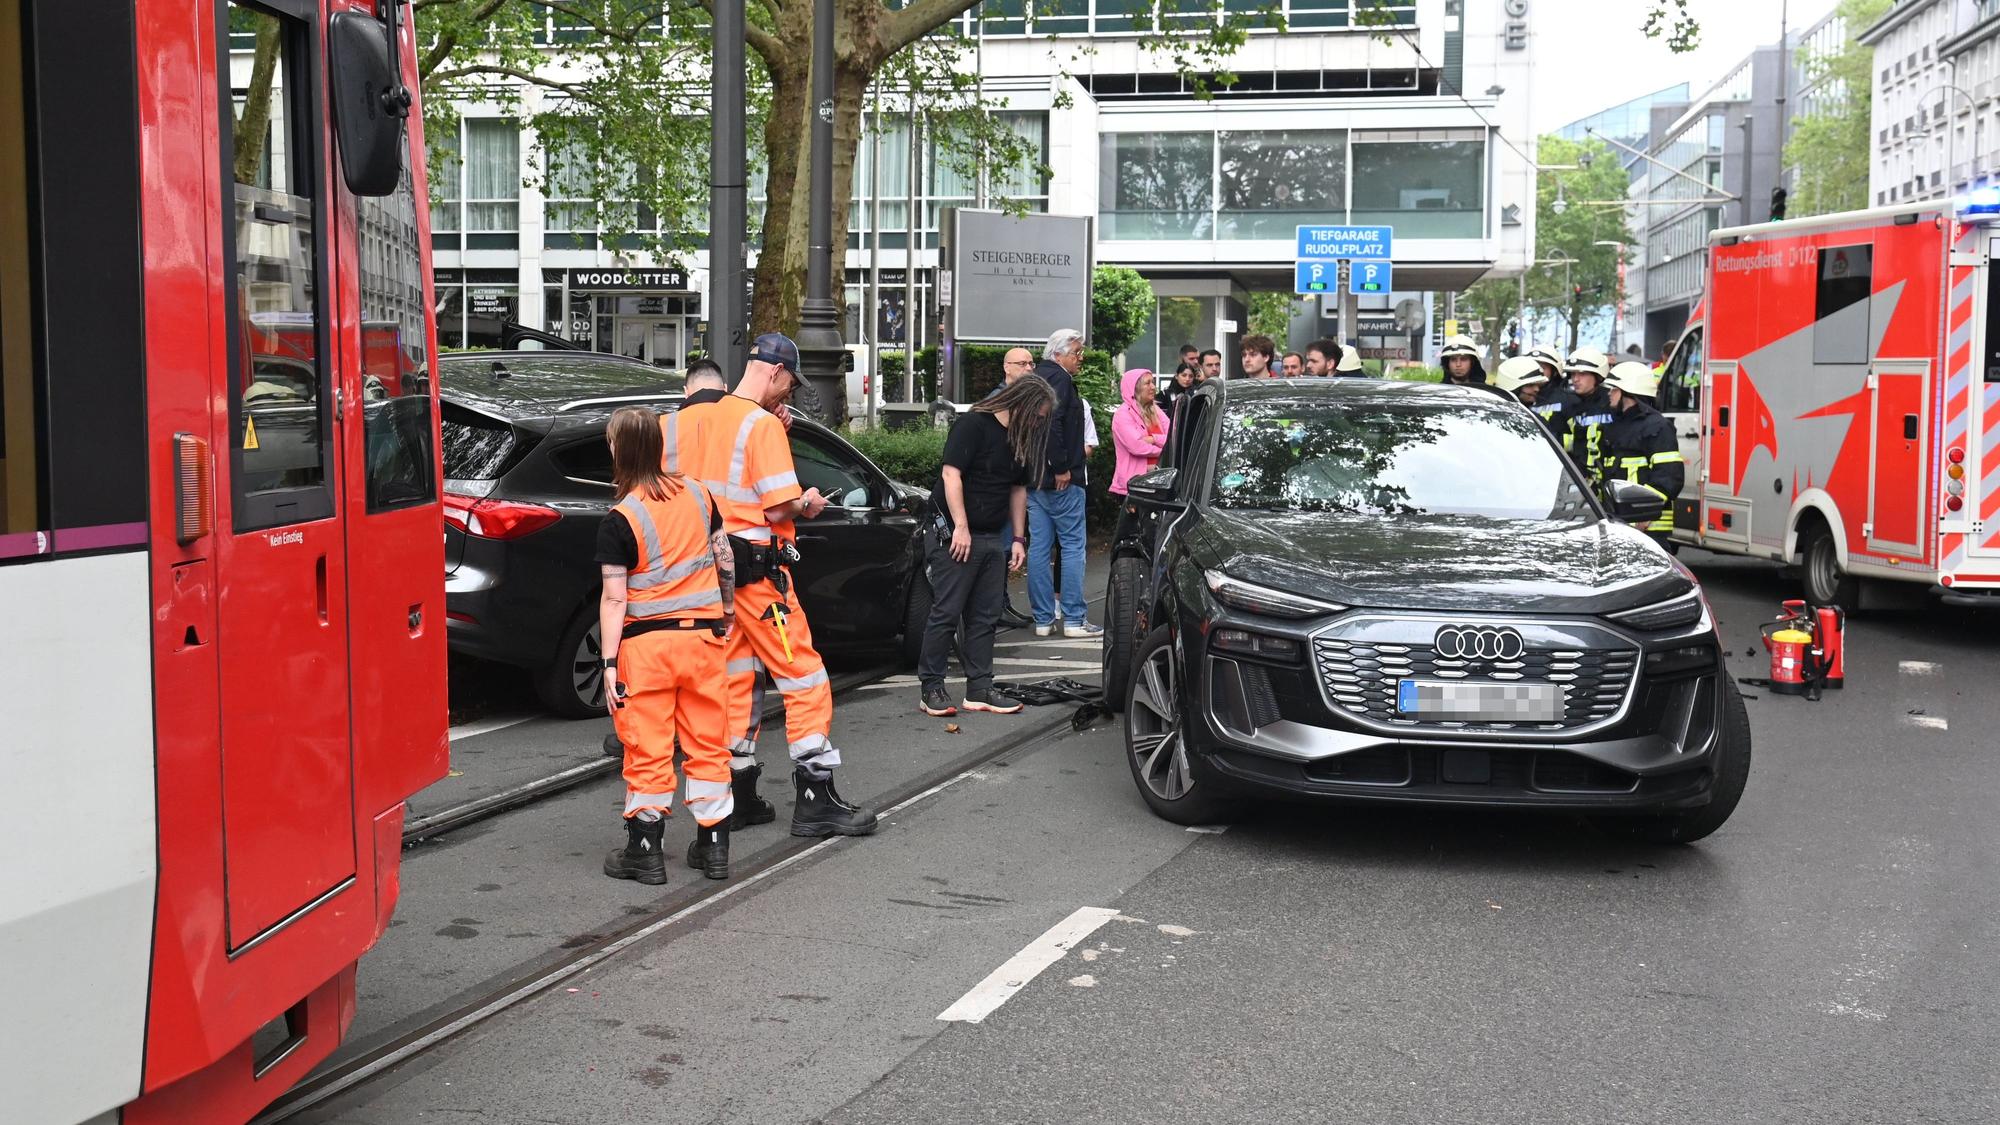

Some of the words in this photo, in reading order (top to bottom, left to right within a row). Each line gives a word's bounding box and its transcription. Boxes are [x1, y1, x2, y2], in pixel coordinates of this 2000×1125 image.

[1310, 230, 1379, 240] TIEFGARAGE
[1305, 243, 1383, 255] RUDOLFPLATZ
[972, 250, 1071, 266] STEIGENBERGER
[1716, 251, 1782, 274] Rettungsdienst
[1799, 246, 1817, 265] 112
[993, 266, 1052, 277] HOTEL
[1013, 278, 1034, 286] KÖLN
[551, 320, 590, 331] WOD
[1357, 322, 1394, 331] INFAHRT
[732, 329, 743, 346] 2
[270, 533, 282, 547] Kein
[283, 530, 303, 544] Einstieg
